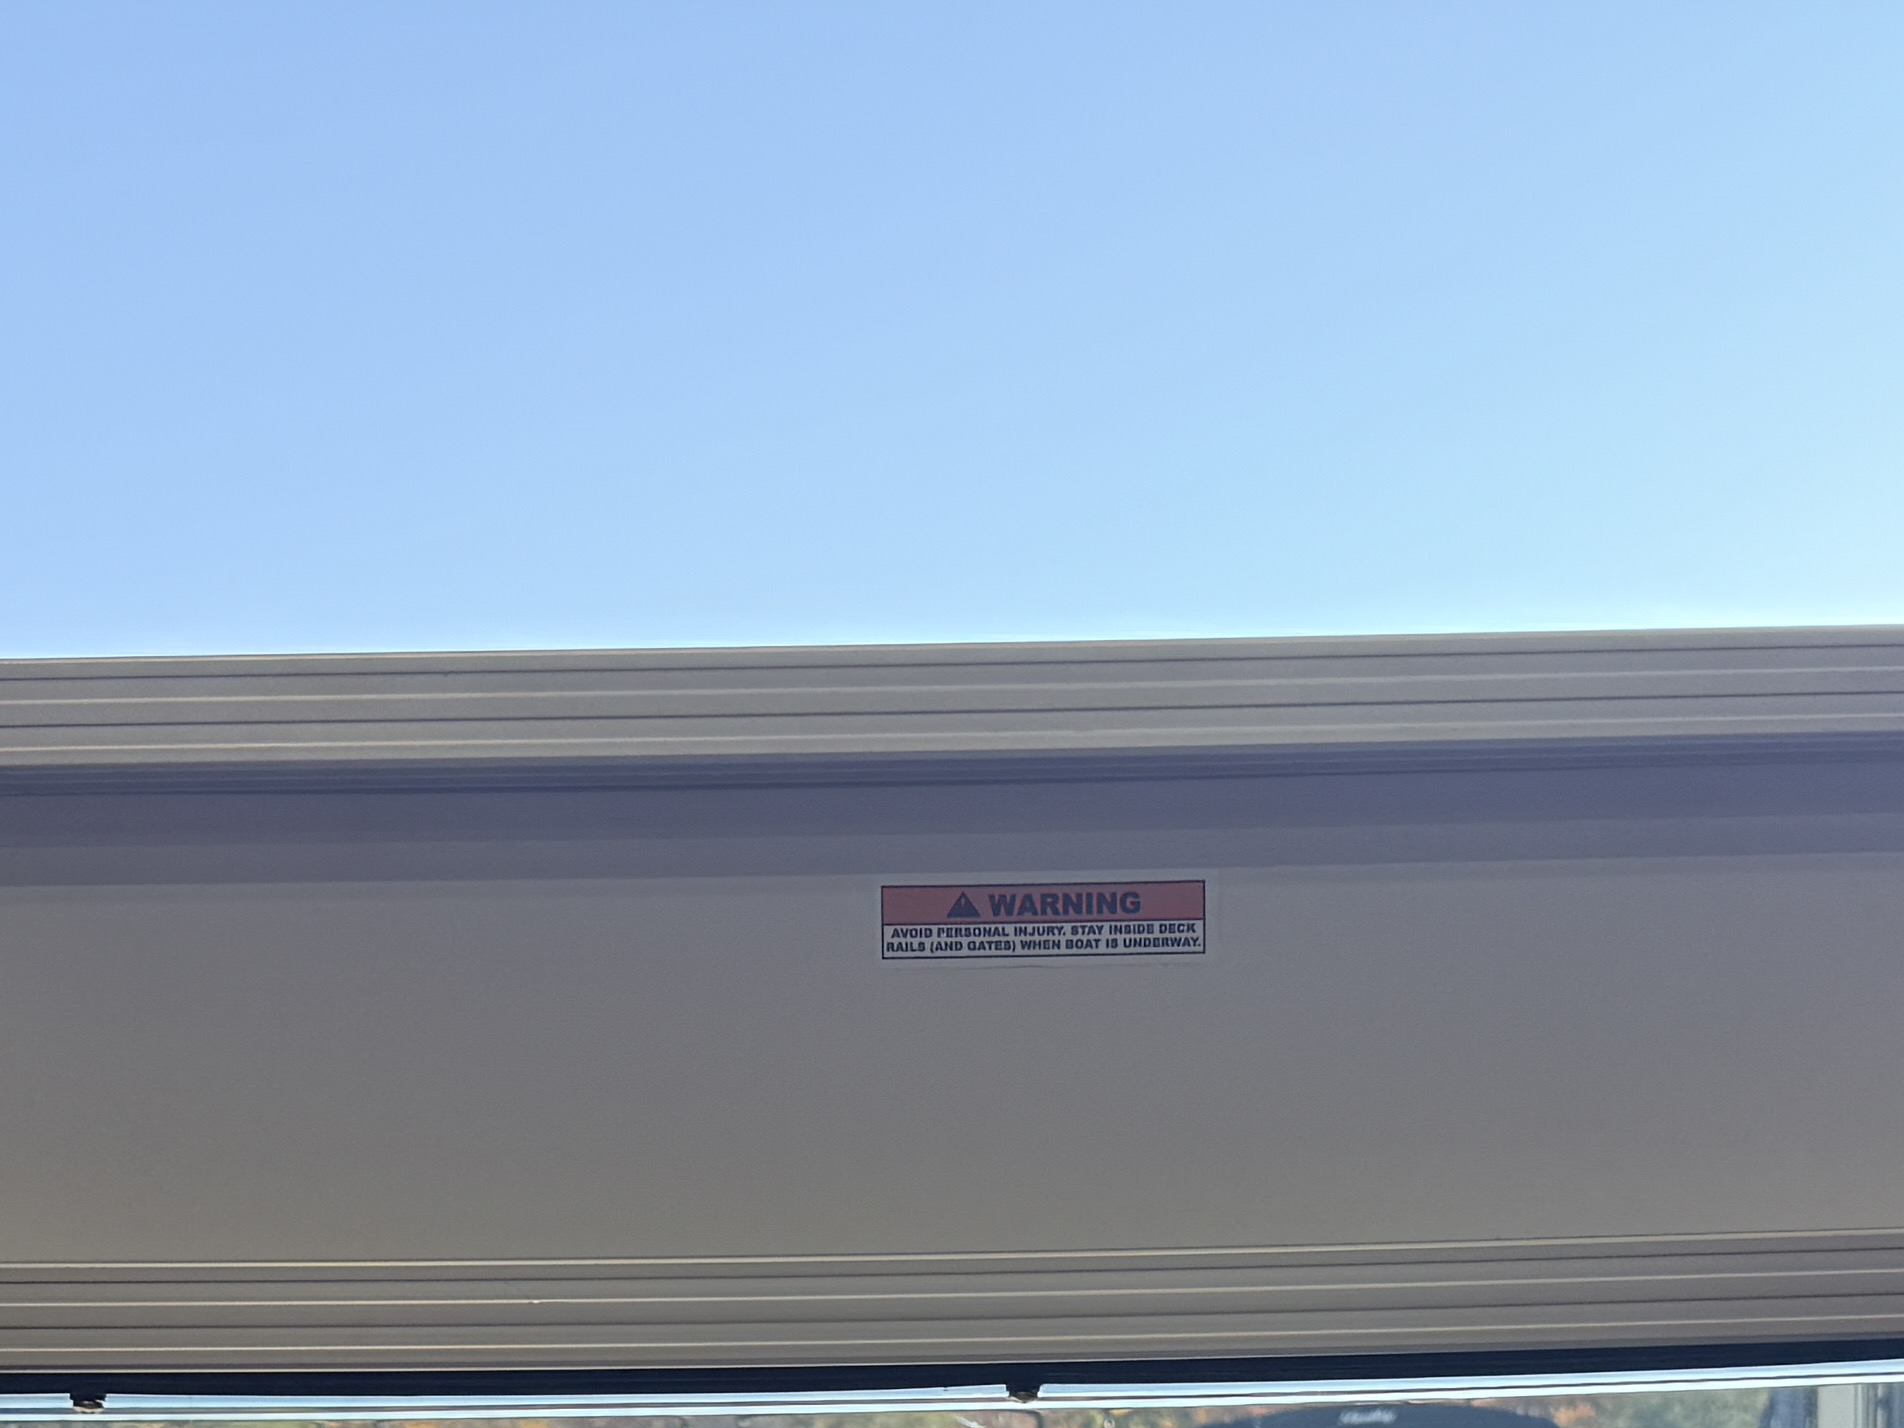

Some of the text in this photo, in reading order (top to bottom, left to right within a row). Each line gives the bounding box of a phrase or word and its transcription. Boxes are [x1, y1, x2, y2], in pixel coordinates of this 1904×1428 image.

[988, 892, 1141, 916] WARNING
[891, 926, 933, 939] AVOID
[937, 926, 1008, 938] PERSONAL
[1071, 924, 1104, 936] STAY
[1109, 923, 1154, 935] INSIDE
[1159, 922, 1196, 934] DECK
[887, 941, 925, 953] RAILS
[930, 940, 963, 953] (AND
[967, 939, 1016, 953] GATES)
[1020, 938, 1062, 950] WHEN
[1066, 936, 1102, 950] BOAT
[1106, 936, 1118, 949] IS
